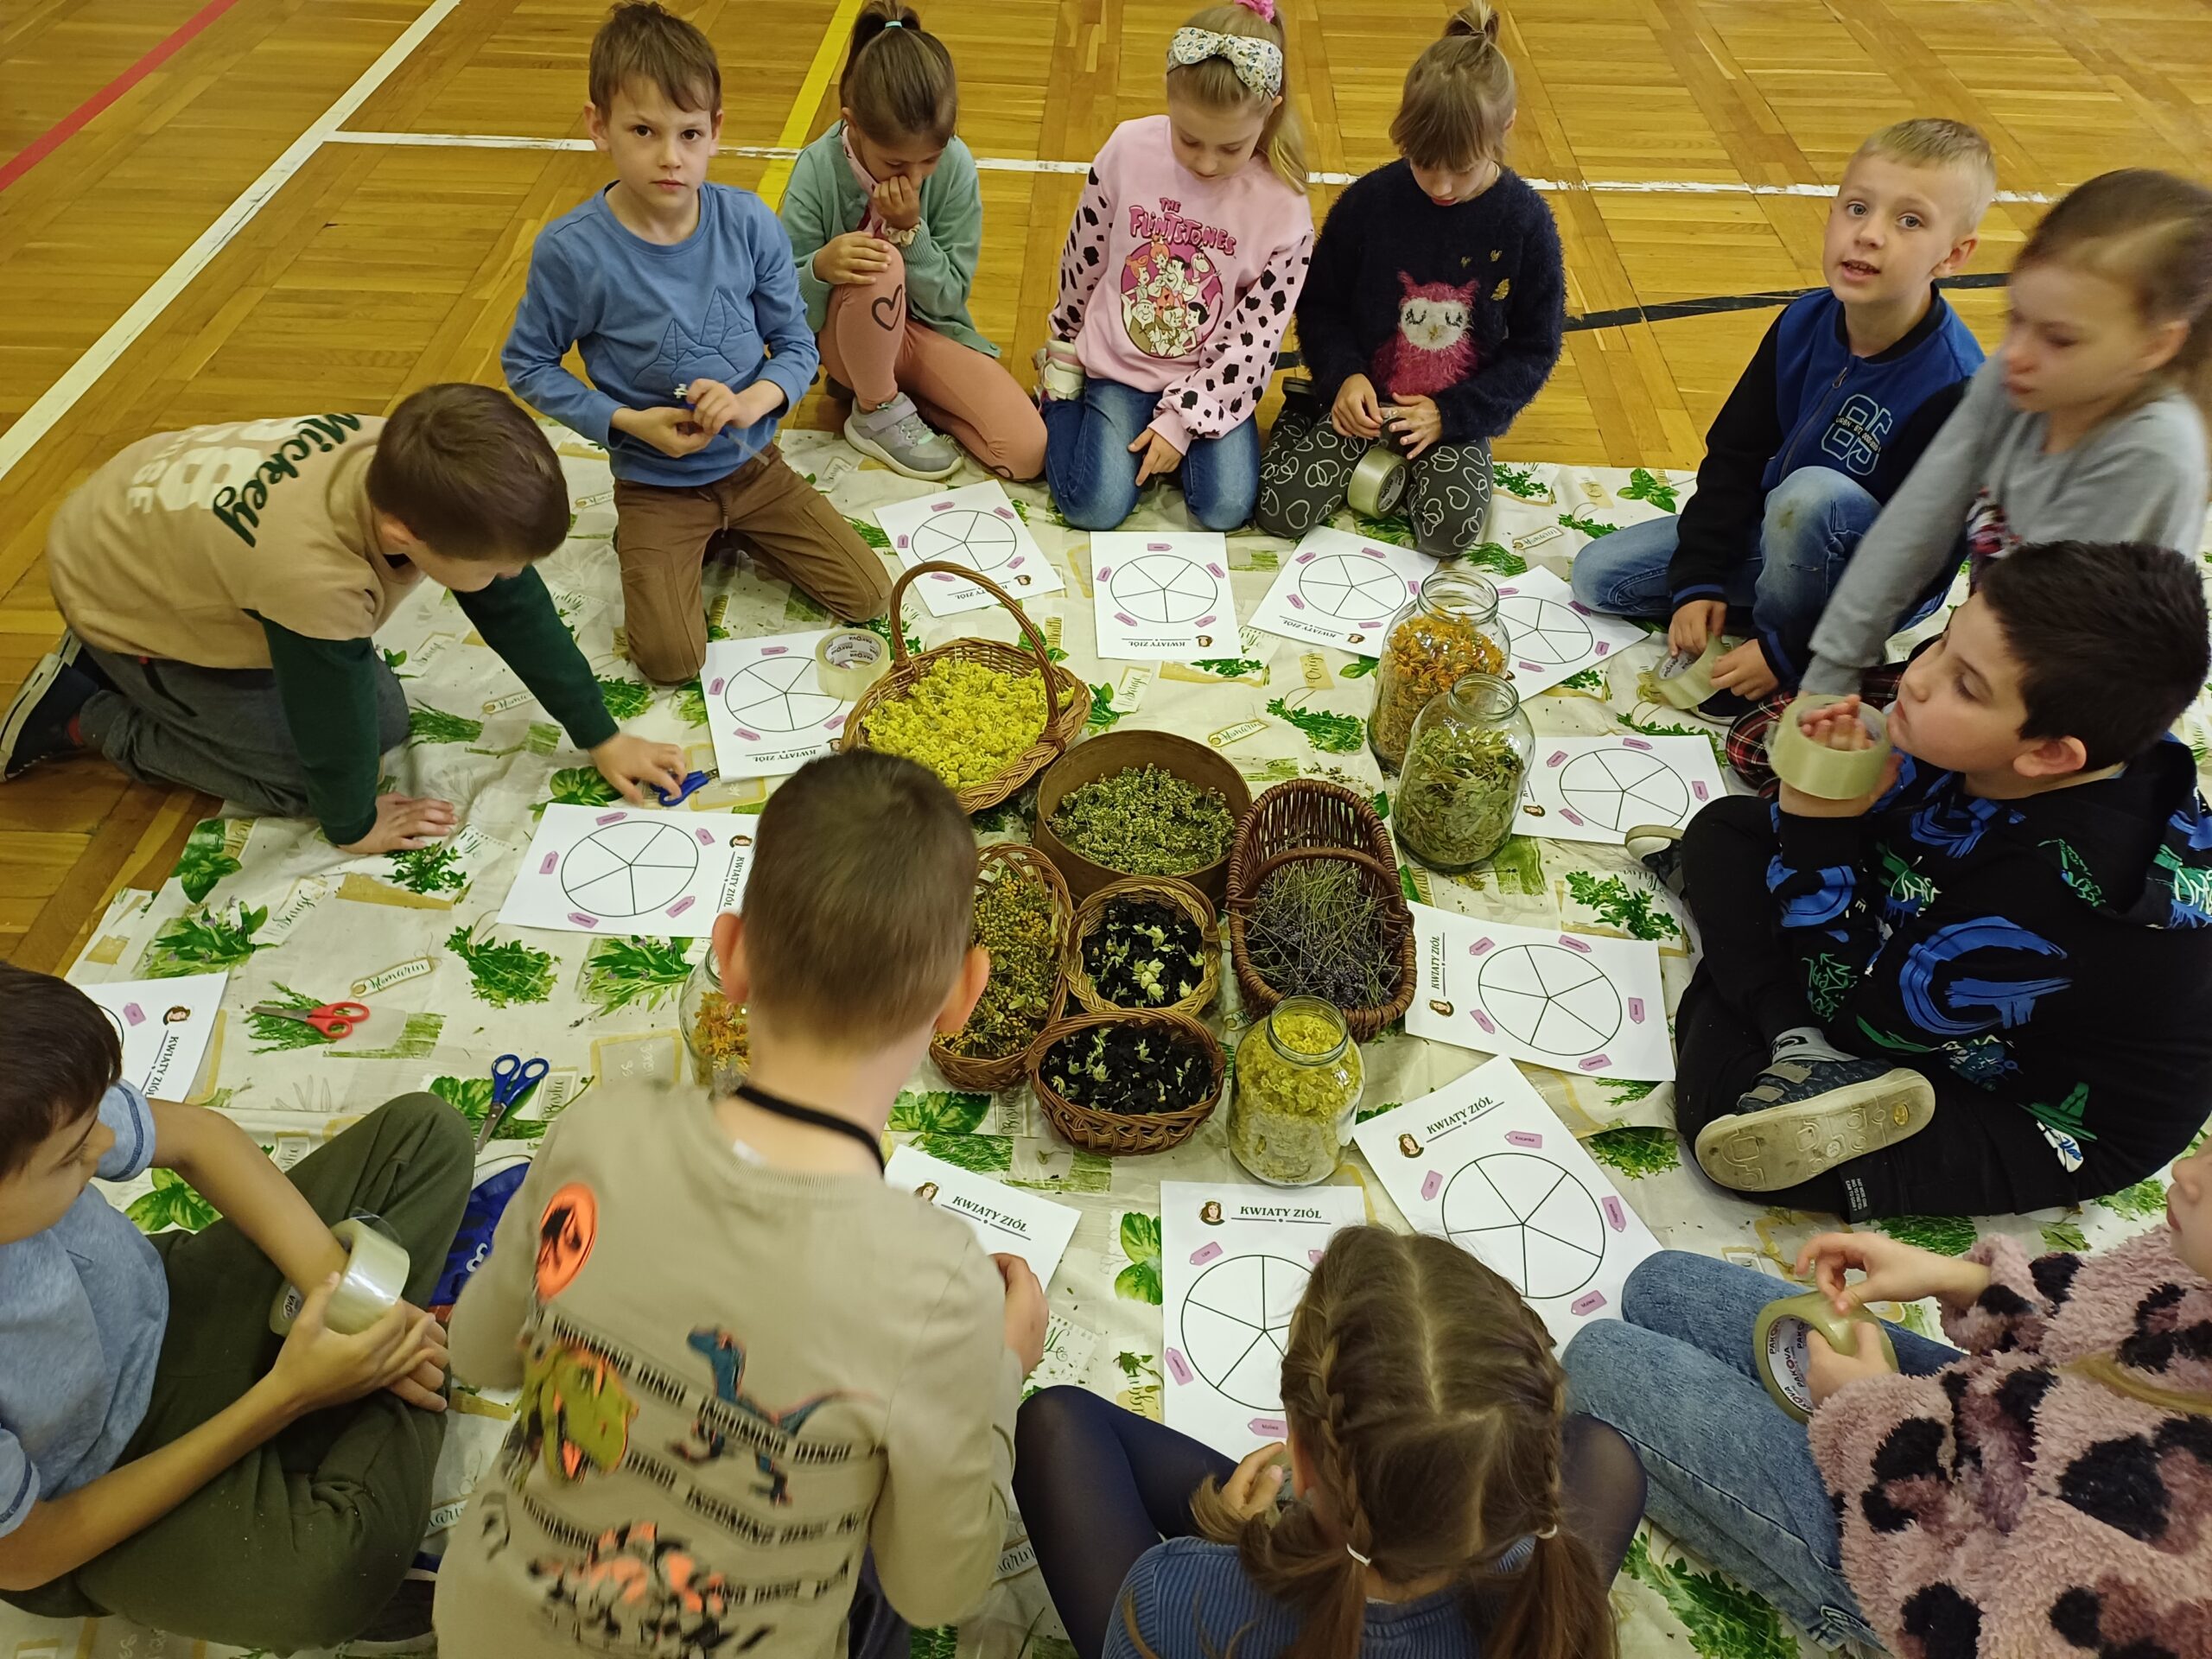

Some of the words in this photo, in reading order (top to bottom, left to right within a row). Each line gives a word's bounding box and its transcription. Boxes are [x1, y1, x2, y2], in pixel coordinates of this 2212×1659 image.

[1160, 197, 1181, 213] THE
[213, 413, 360, 548] Mickey
[1302, 626, 1337, 639] KWIATY
[778, 750, 817, 760] KWIATY
[729, 856, 745, 887] KWIATY
[1431, 957, 1440, 989] KWIATY
[157, 1036, 179, 1076] KWIATY
[1427, 1109, 1468, 1135] KWIATY
[952, 1196, 1001, 1220] KWIATY
[1240, 1206, 1291, 1217] KWIATY
[1784, 1347, 1806, 1388] PAKOVA
[1784, 1386, 1814, 1411] AKOVA
